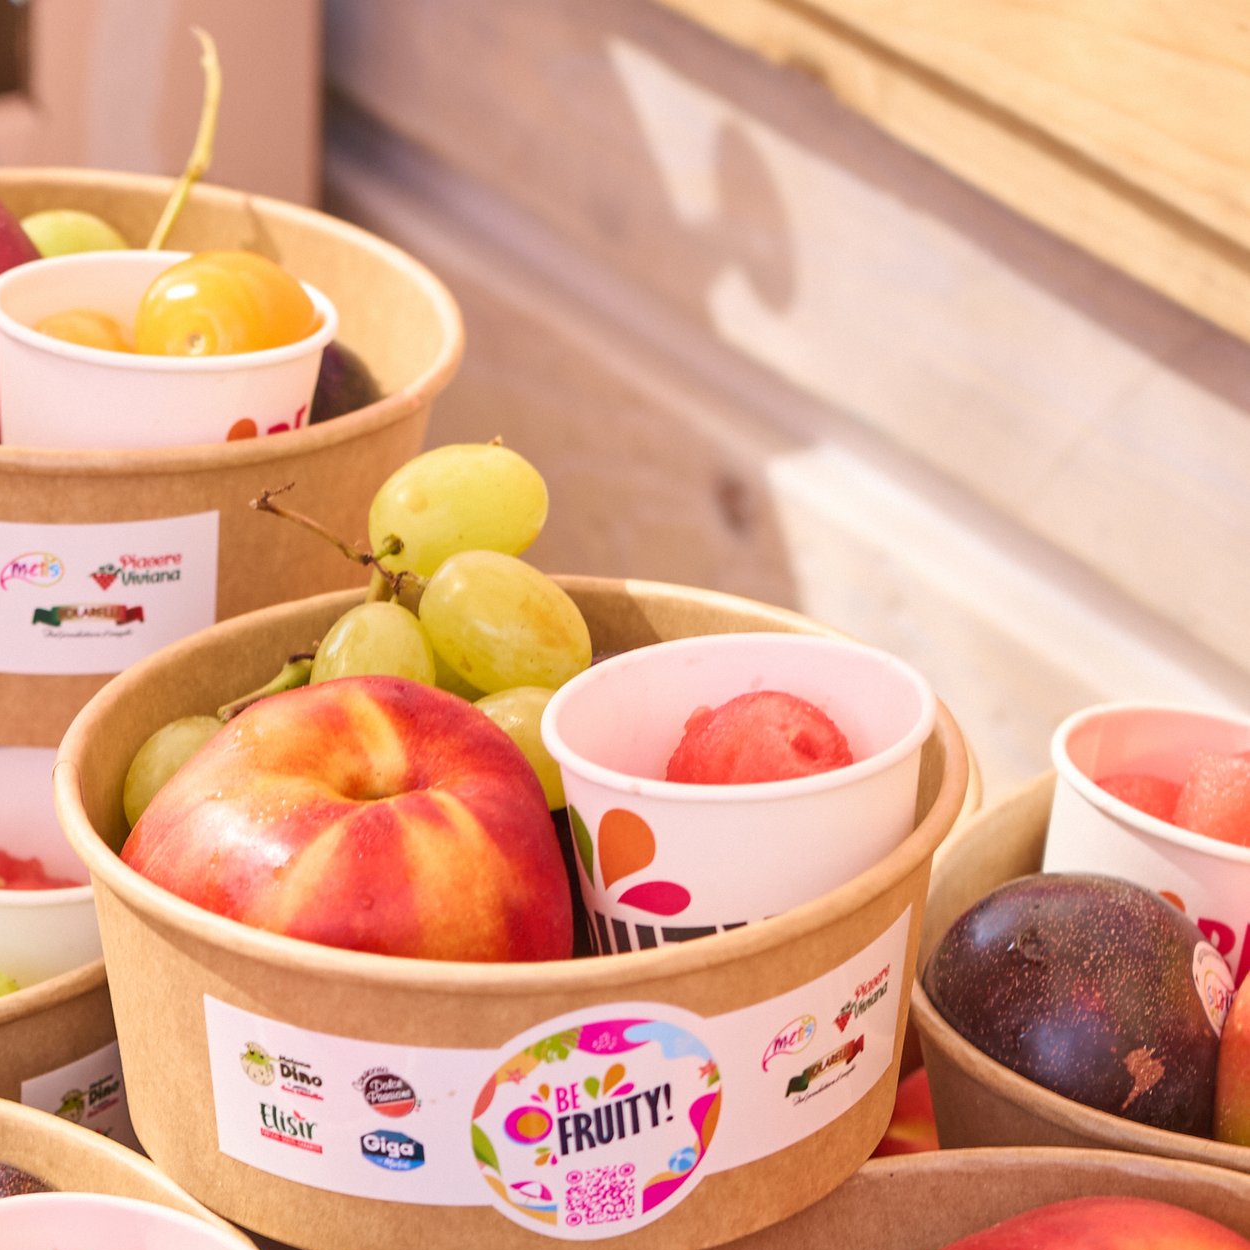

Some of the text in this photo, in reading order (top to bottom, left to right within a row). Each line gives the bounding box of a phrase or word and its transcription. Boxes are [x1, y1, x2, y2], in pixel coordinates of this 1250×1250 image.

[120, 569, 181, 587] Viviana
[280, 1063, 323, 1087] Dino
[555, 1082, 580, 1113] BE
[259, 1102, 318, 1141] Elisir
[558, 1083, 674, 1156] FRUITY!
[362, 1134, 415, 1159] Giga
